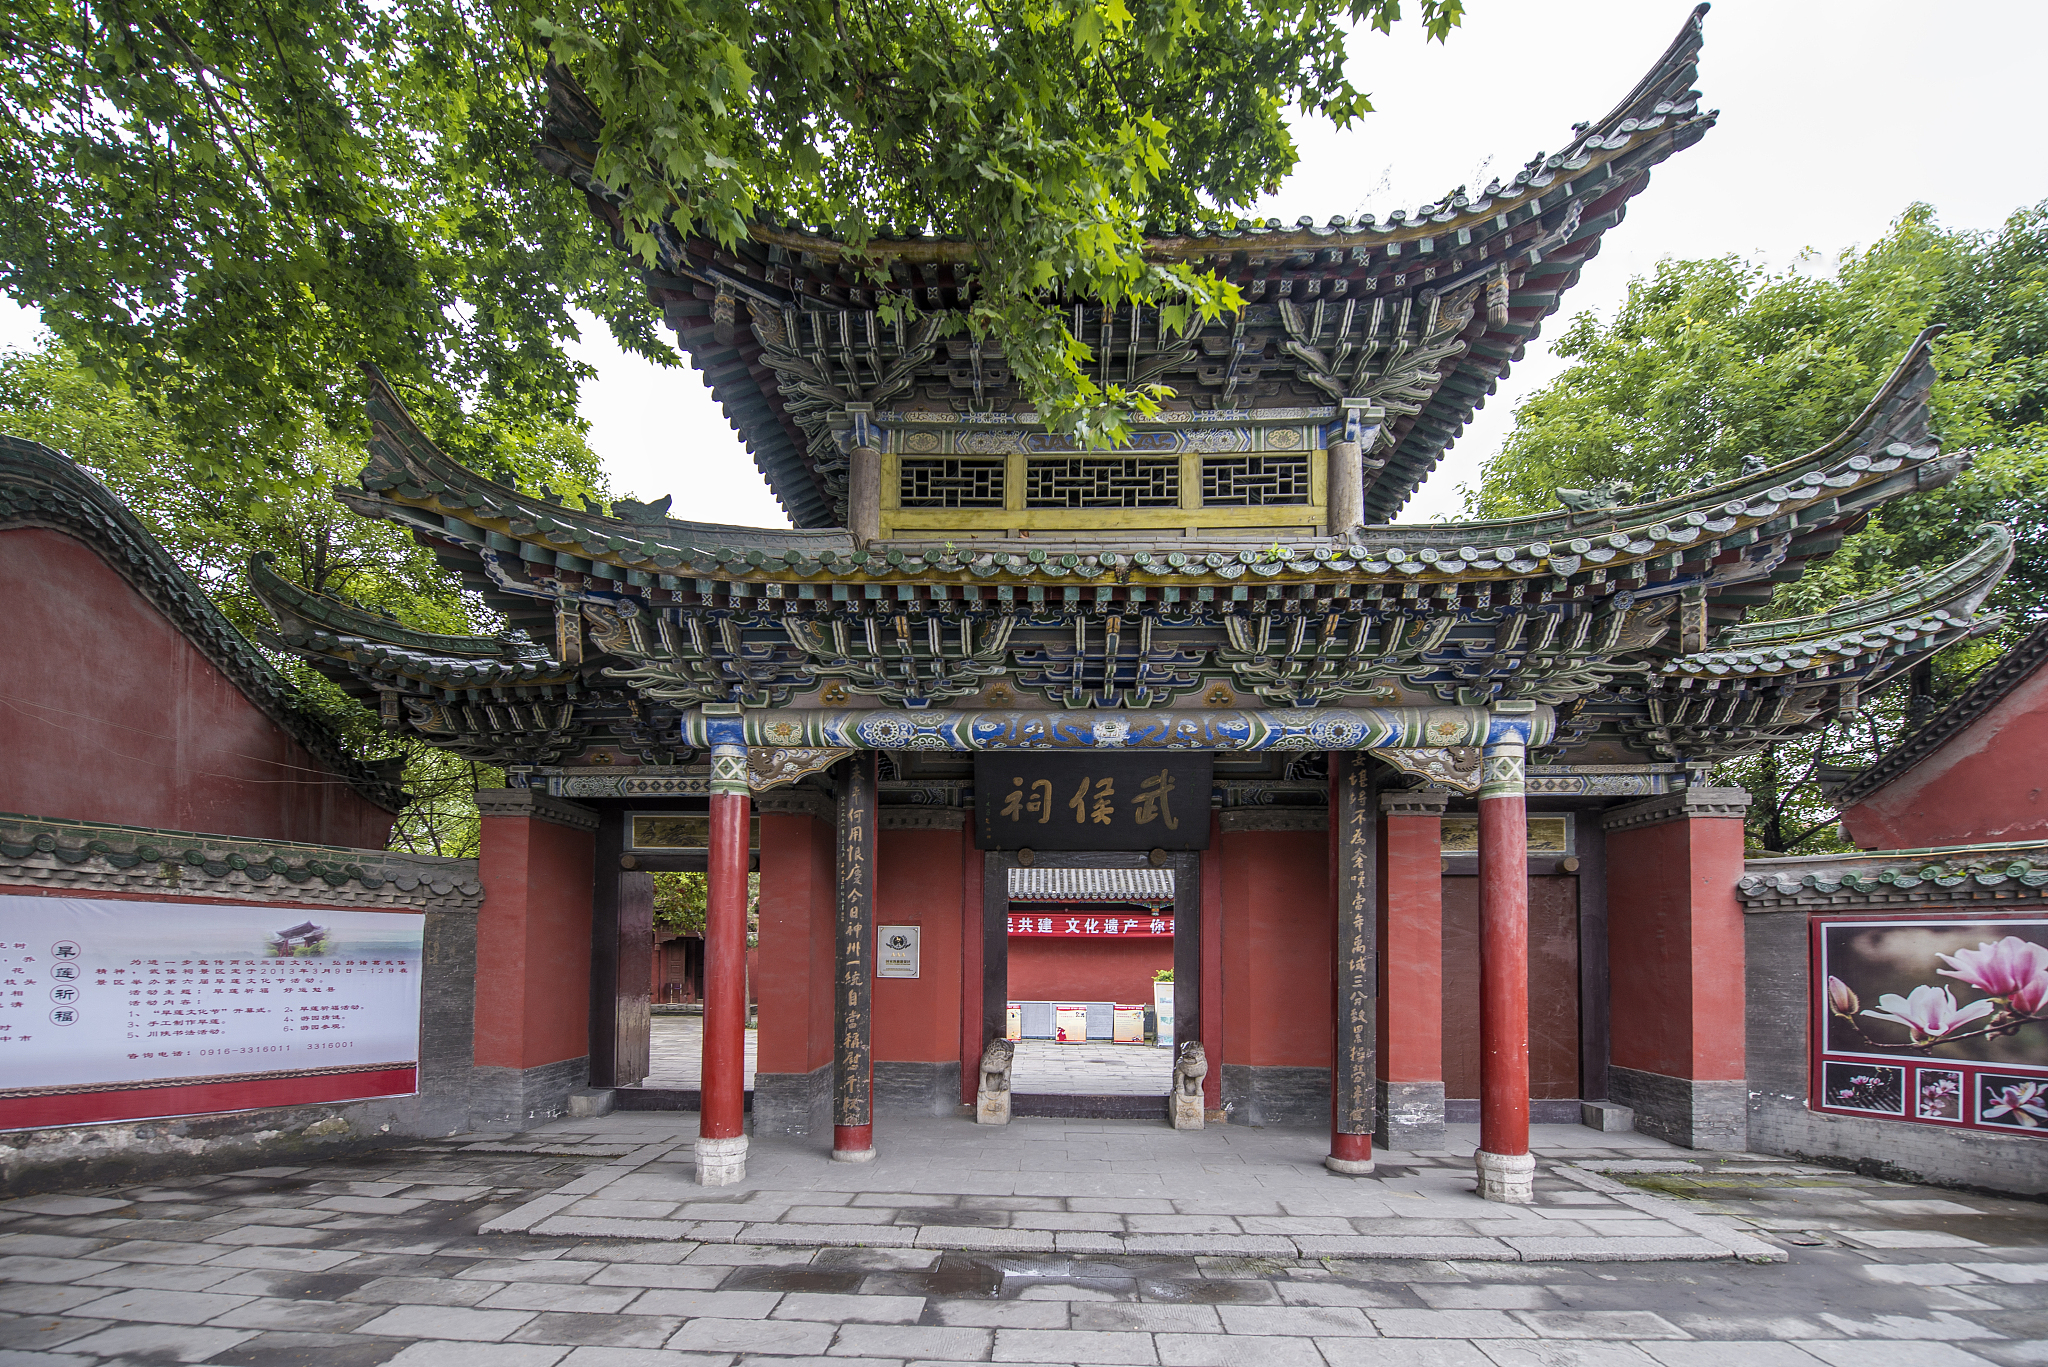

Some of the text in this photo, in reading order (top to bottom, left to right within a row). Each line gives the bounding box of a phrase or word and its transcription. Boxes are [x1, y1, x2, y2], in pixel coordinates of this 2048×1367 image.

[999, 767, 1180, 831] 武侯祠
[1065, 917, 1139, 934] 文化遗产
